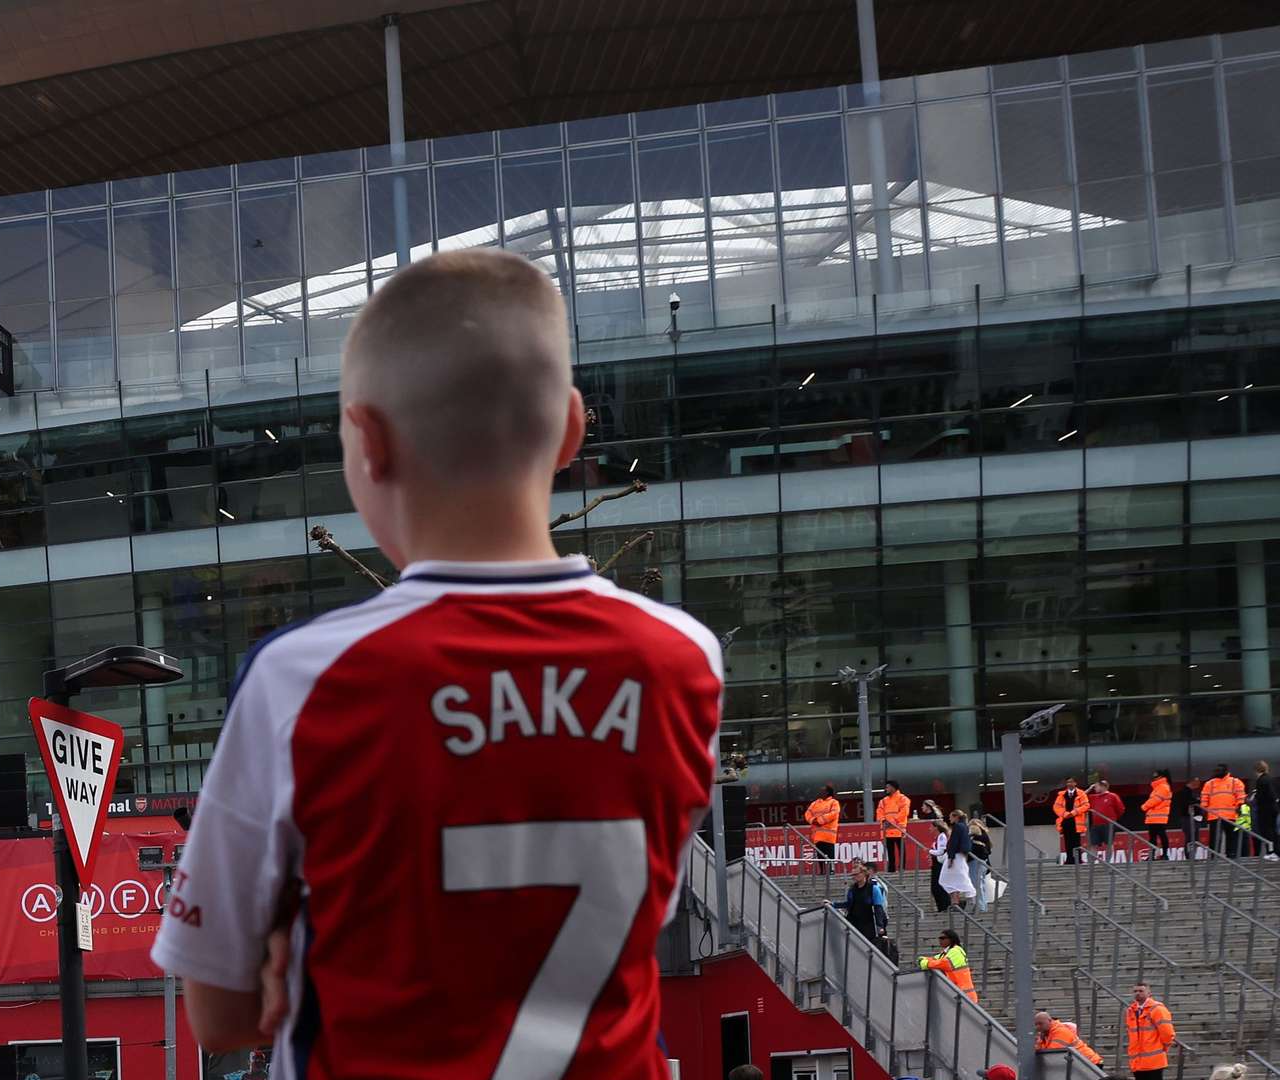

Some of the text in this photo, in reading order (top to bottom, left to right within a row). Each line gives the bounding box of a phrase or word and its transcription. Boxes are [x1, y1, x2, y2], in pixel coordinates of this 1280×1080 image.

[432, 665, 643, 755] SAKA
[52, 729, 104, 776] GIVE
[65, 776, 98, 806] WAY
[150, 797, 196, 810] MATCH
